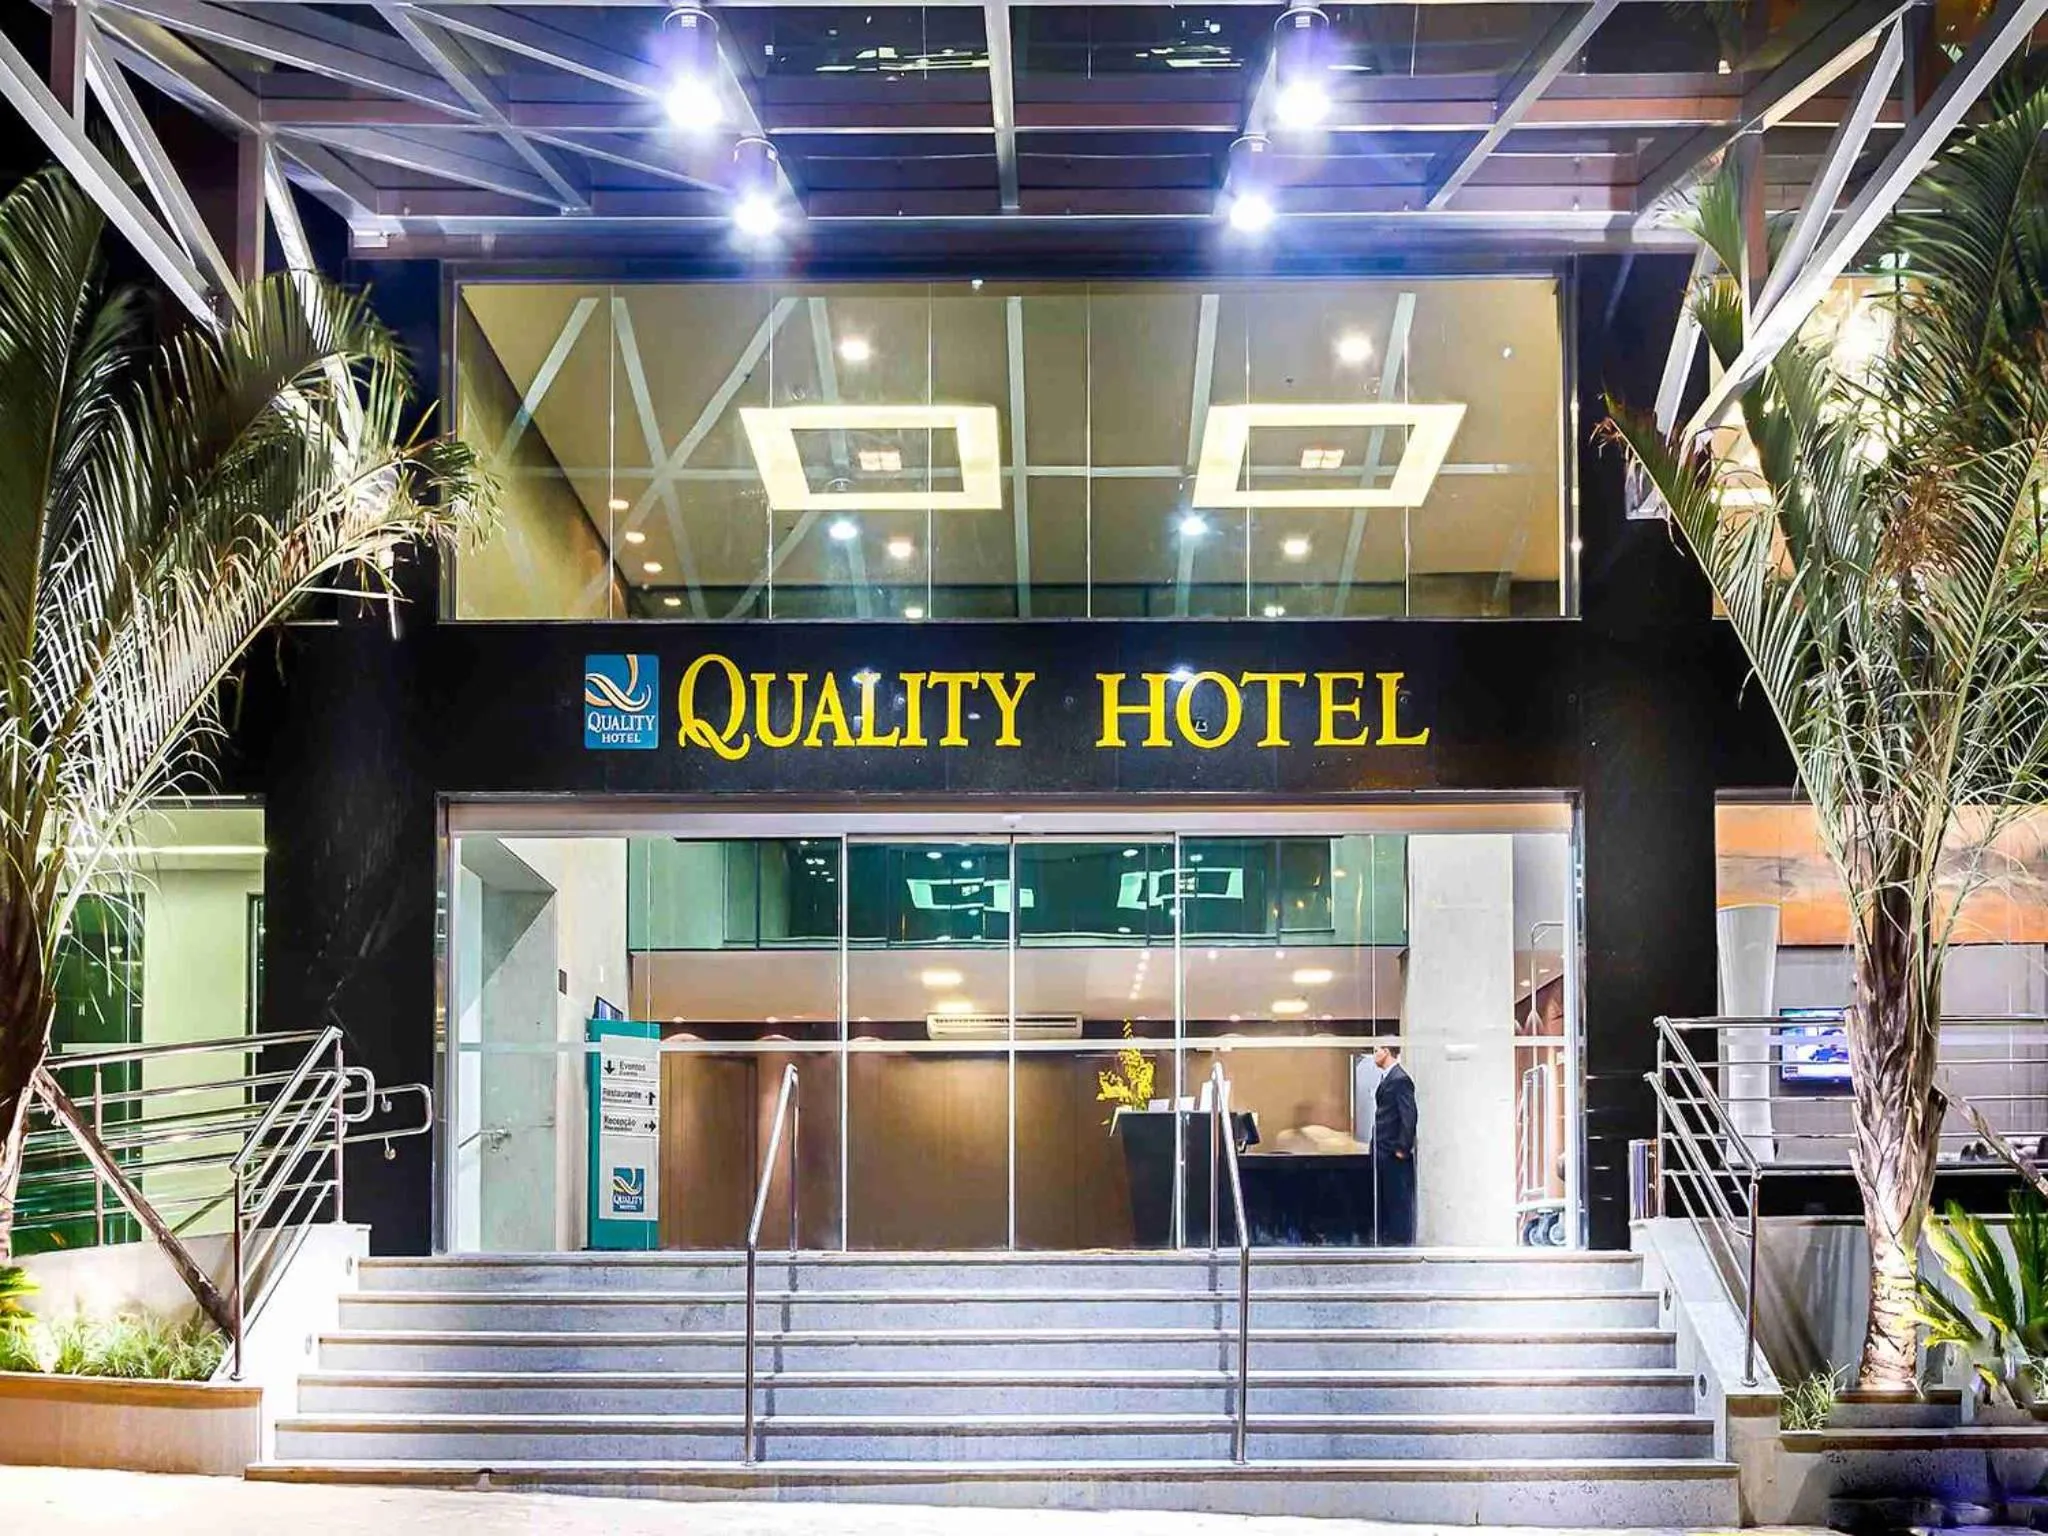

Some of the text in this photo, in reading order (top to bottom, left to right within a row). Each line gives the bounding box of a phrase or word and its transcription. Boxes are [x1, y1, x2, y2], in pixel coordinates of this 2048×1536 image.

[678, 653, 1431, 761] QUALITY HOTEL
[588, 711, 656, 733] QUALITY
[601, 732, 642, 744] HOTEL
[620, 1060, 646, 1071] Eventos
[603, 1087, 641, 1099] Restaurante
